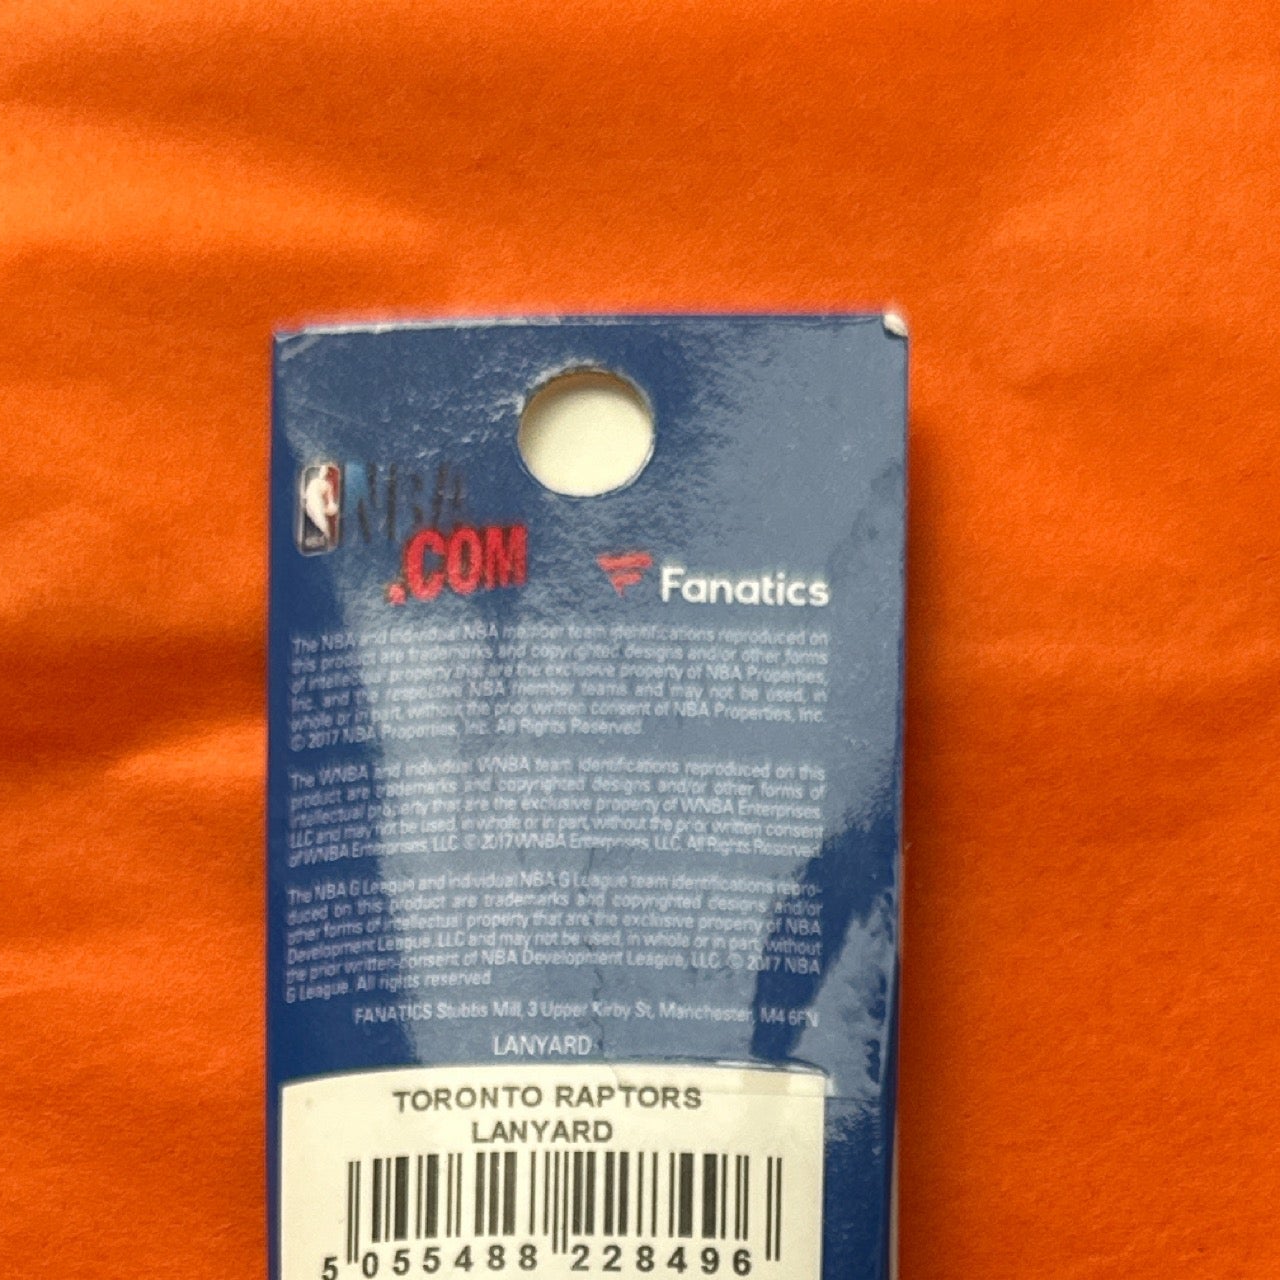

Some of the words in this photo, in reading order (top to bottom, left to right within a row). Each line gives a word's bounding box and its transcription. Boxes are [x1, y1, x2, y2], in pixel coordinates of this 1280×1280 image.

[660, 565, 830, 607] Fanatics
[355, 1001, 433, 1024] FANATICS
[436, 1001, 489, 1019] Stubbs
[527, 1001, 538, 1018] 3
[541, 1001, 587, 1020] Upper
[493, 1035, 592, 1056] LANYARD
[394, 1085, 543, 1112] TORONTO
[555, 1085, 702, 1110] RAPTORS
[472, 1120, 613, 1144] LANYARD
[361, 1244, 538, 1278] 055488
[570, 1245, 752, 1276] 228496
